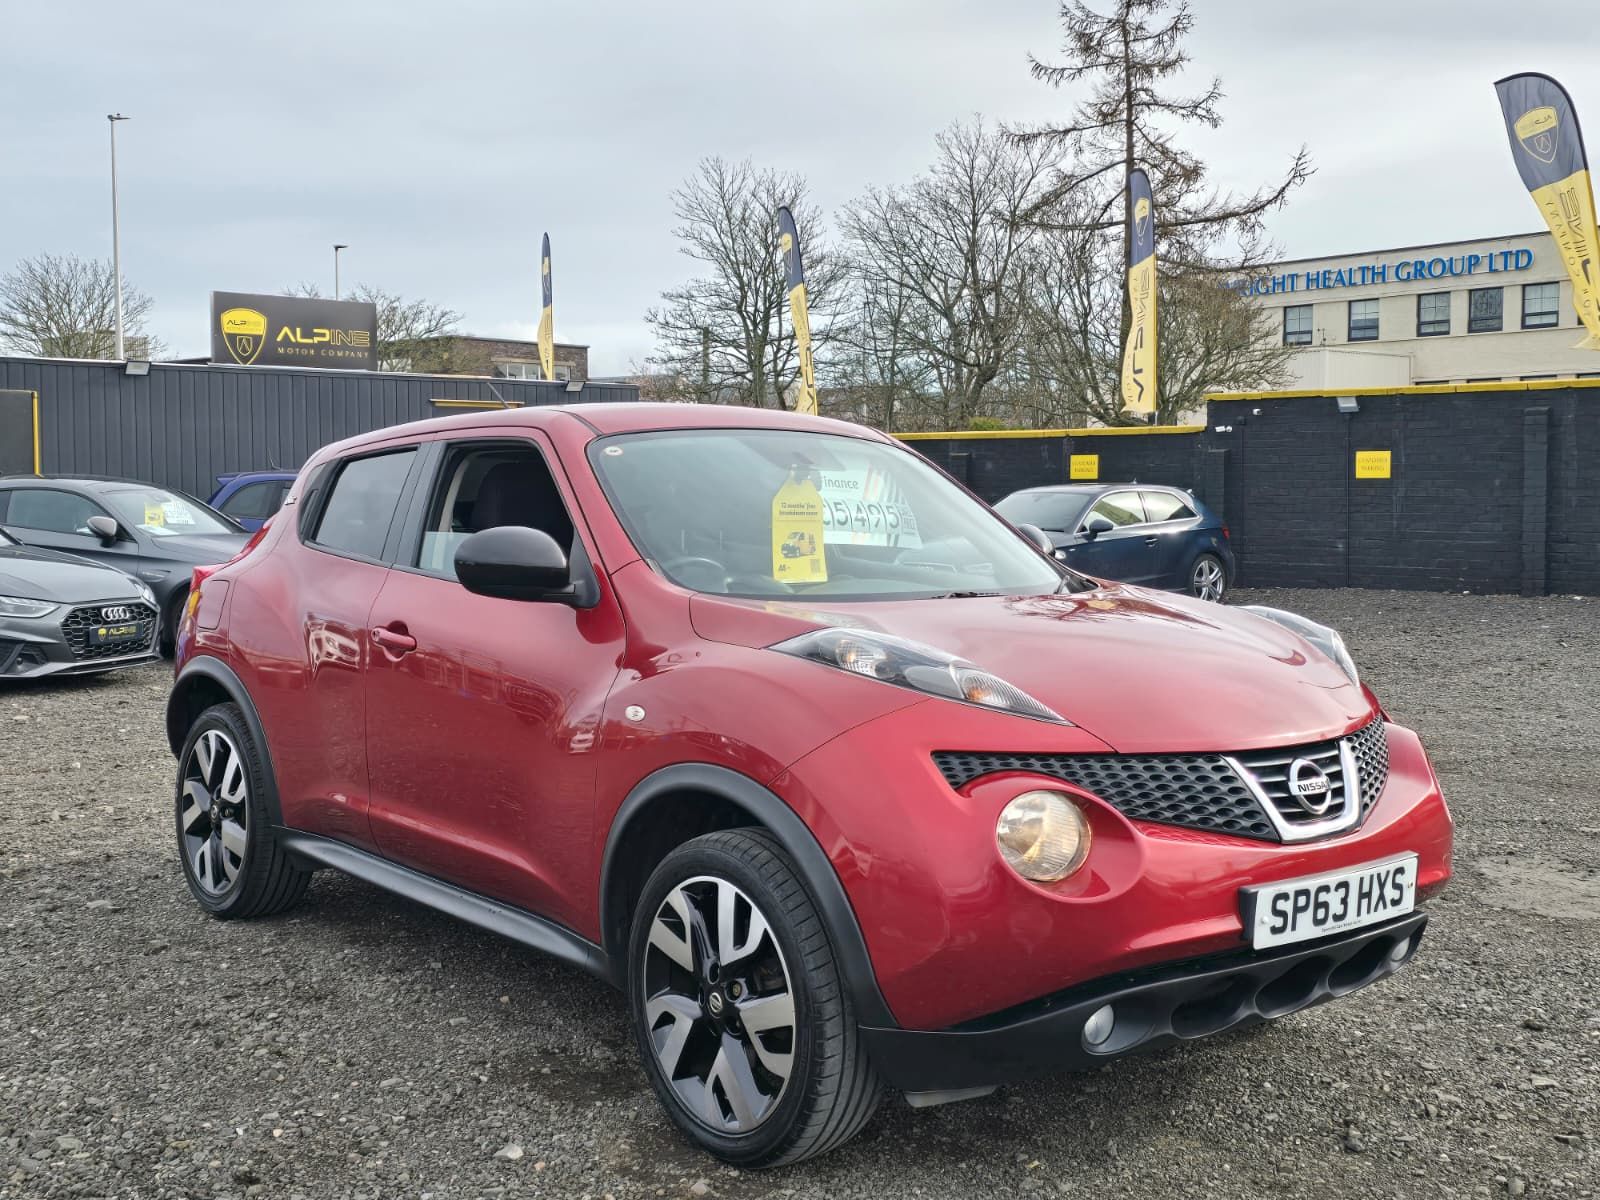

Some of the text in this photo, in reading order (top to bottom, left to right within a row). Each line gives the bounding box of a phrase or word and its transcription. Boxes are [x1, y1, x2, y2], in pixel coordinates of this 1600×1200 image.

[1305, 263, 1387, 289] HEALTH
[1395, 254, 1481, 281] GROUP
[1488, 248, 1534, 273] LTD
[276, 326, 370, 348] ALPINE
[277, 347, 369, 359] MOTOR COMPANY
[824, 475, 859, 489] inance
[1270, 866, 1406, 935] SP63 HXS
